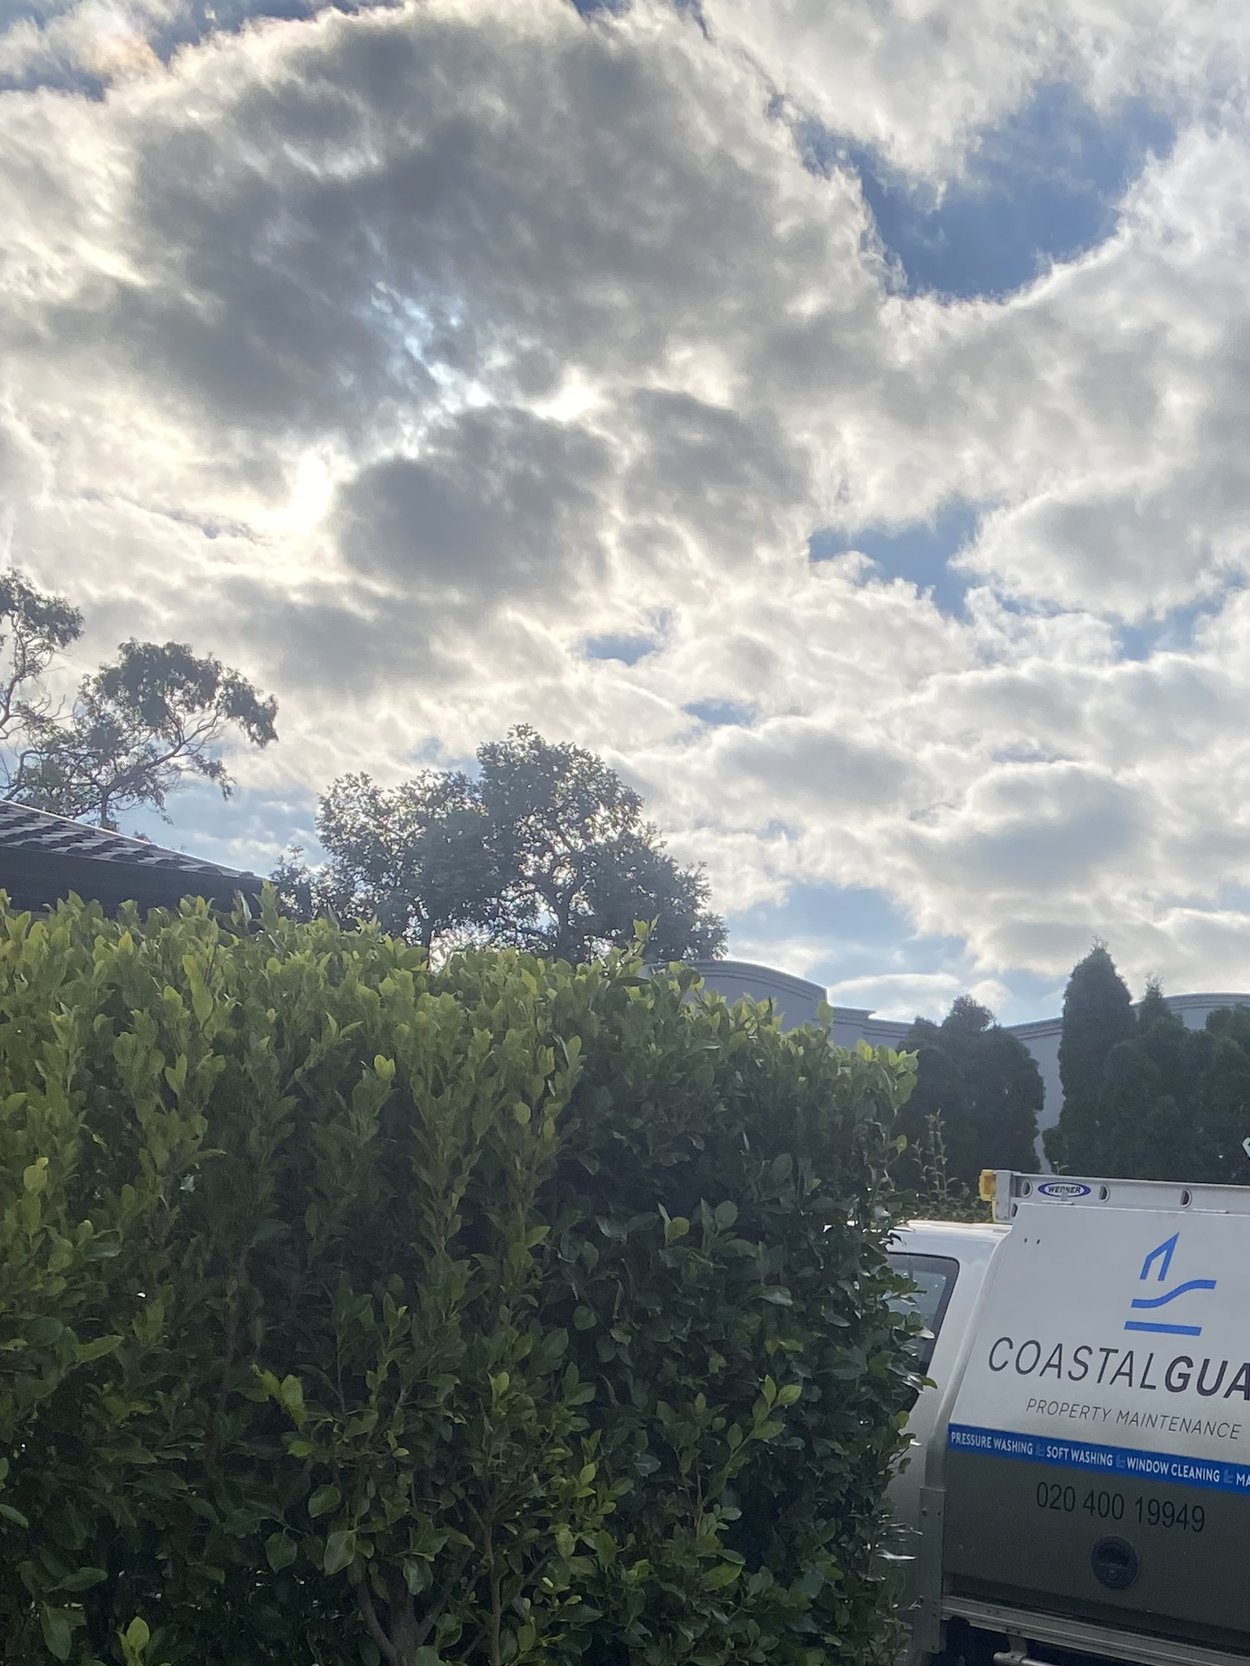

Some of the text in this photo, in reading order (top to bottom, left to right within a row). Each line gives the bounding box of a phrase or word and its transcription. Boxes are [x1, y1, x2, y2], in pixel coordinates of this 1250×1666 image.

[1026, 1398, 1243, 1440] PROPERTY MAINTENANCE
[951, 1431, 991, 1449] PRESSURE
[993, 1438, 1033, 1455] WASHING
[1046, 1445, 1069, 1461] SOFT
[1070, 1449, 1113, 1467] WASHING
[1126, 1456, 1169, 1474] WINDOW
[1171, 1464, 1220, 1483] CLEANING
[1036, 1481, 1206, 1533] 020 400 19949
